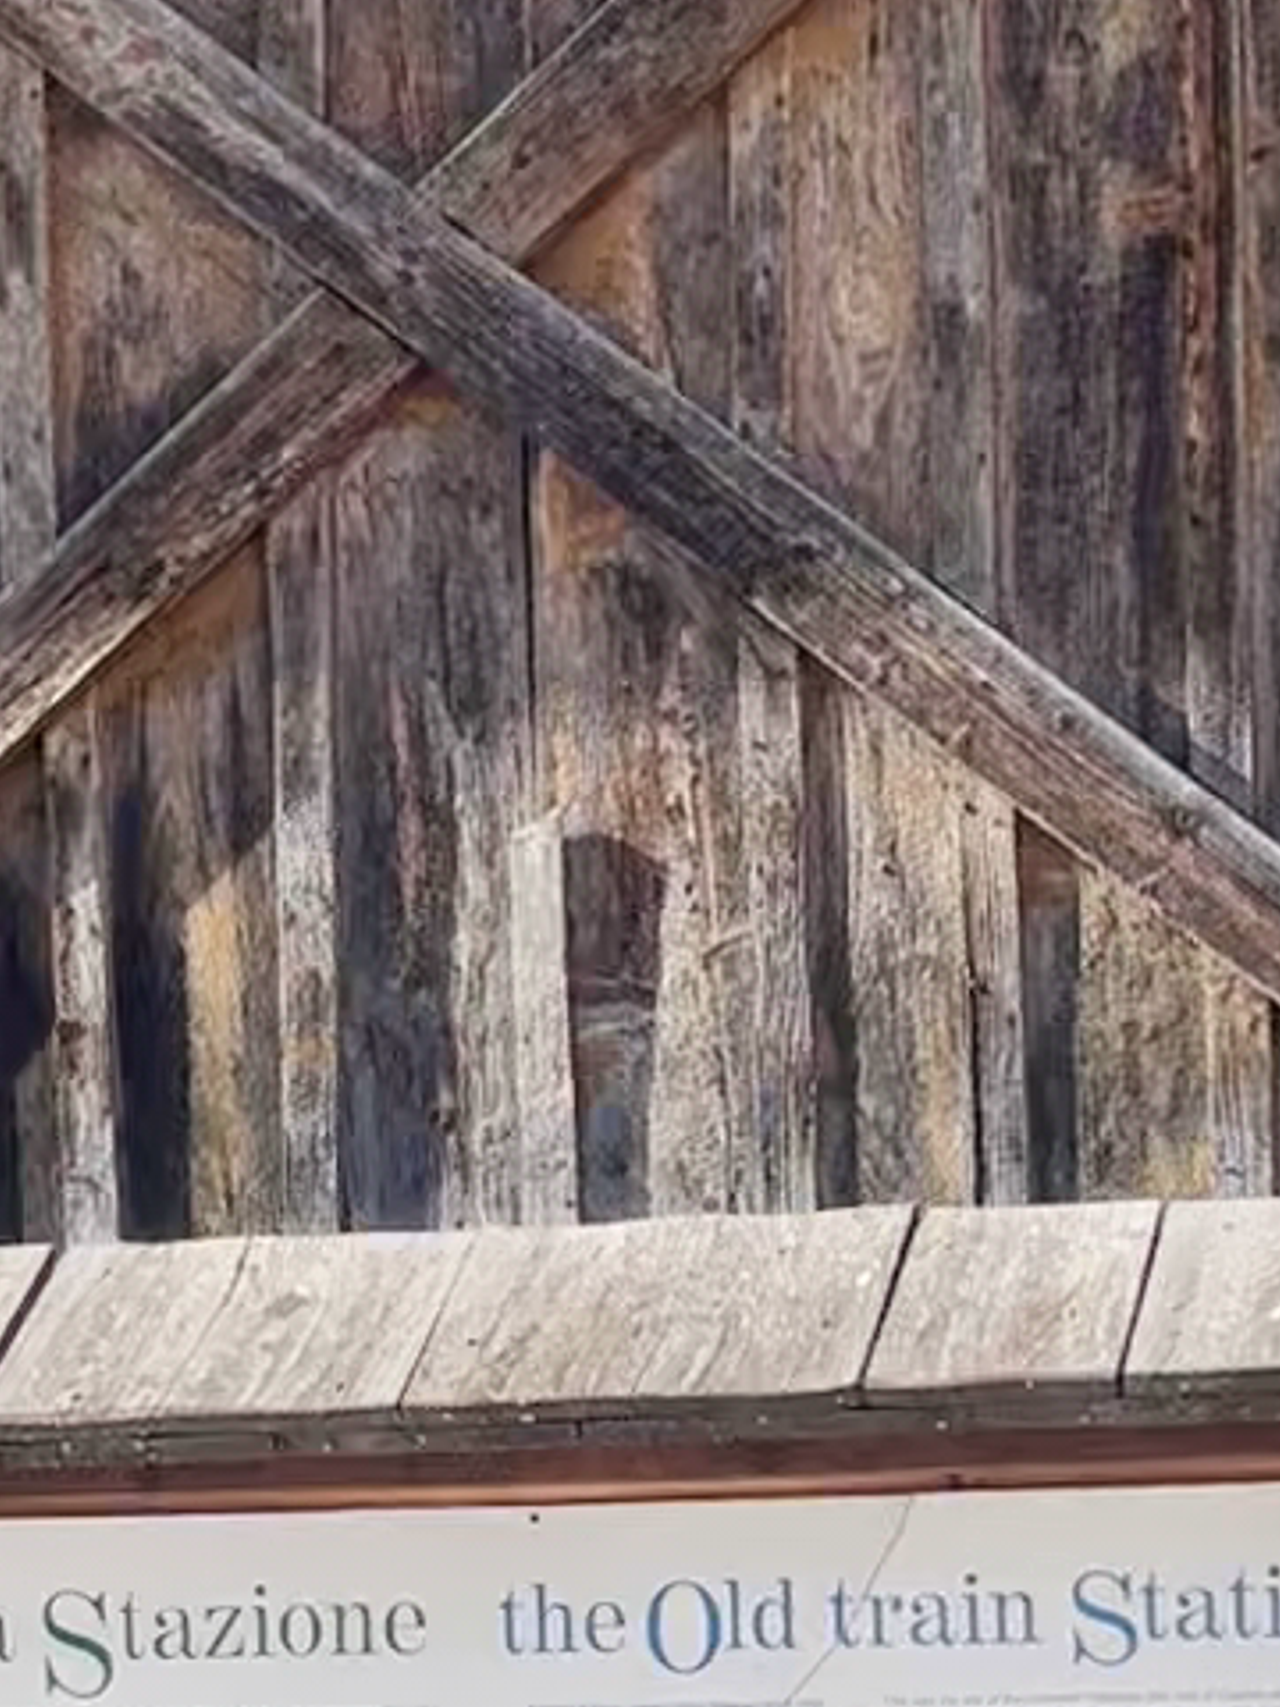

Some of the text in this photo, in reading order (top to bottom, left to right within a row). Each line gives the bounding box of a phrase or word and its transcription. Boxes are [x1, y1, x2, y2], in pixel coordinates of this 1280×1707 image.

[42, 1584, 427, 1700] Stazione
[499, 1582, 626, 1655] the
[646, 1576, 797, 1675] Old
[828, 1573, 1042, 1647] train
